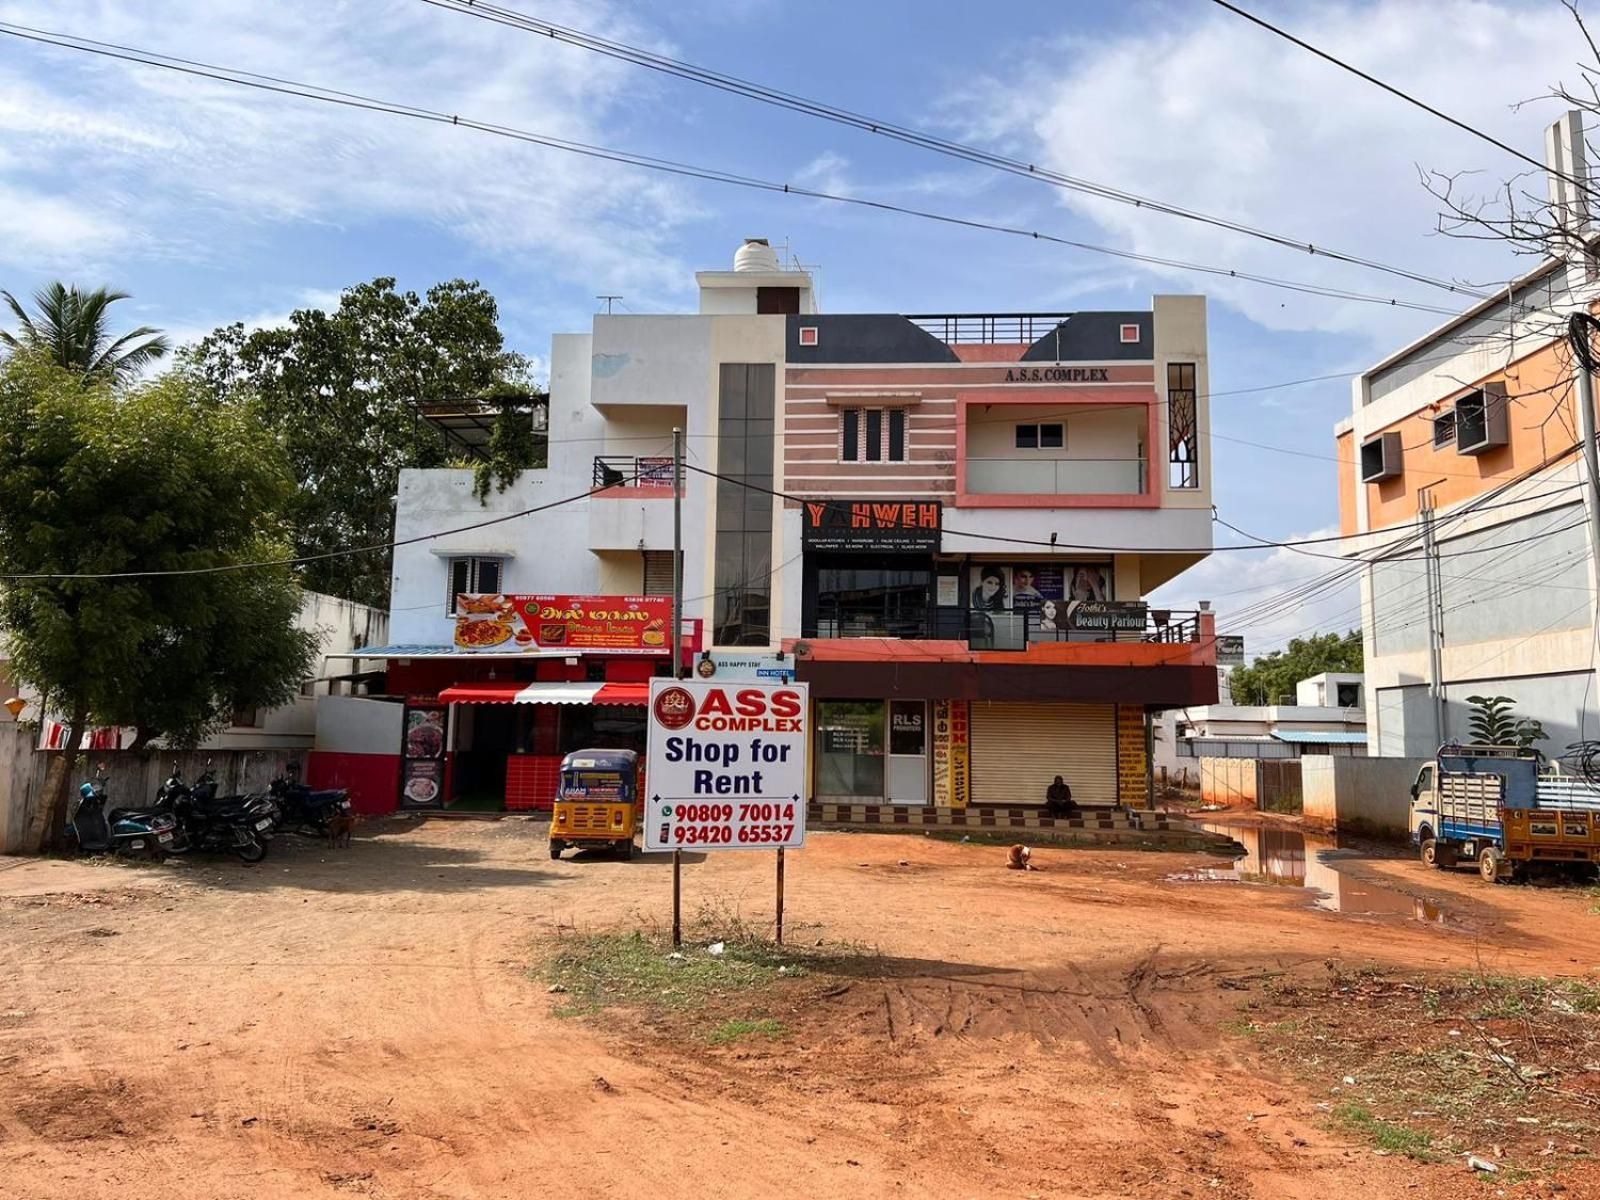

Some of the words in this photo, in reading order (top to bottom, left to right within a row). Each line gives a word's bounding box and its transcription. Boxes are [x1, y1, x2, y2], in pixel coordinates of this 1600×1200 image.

[1076, 614, 1109, 629] Beauty
[1111, 614, 1146, 628] Parlour
[697, 688, 801, 717] ASS
[695, 717, 803, 732] COMPLEX
[893, 714, 921, 725] RLS
[665, 737, 739, 767] Shop
[750, 738, 791, 762] for
[693, 770, 763, 794] Rent
[675, 804, 733, 822] 90809
[738, 804, 794, 822] 70014
[674, 825, 732, 844] 93420
[738, 824, 795, 842] 65537
